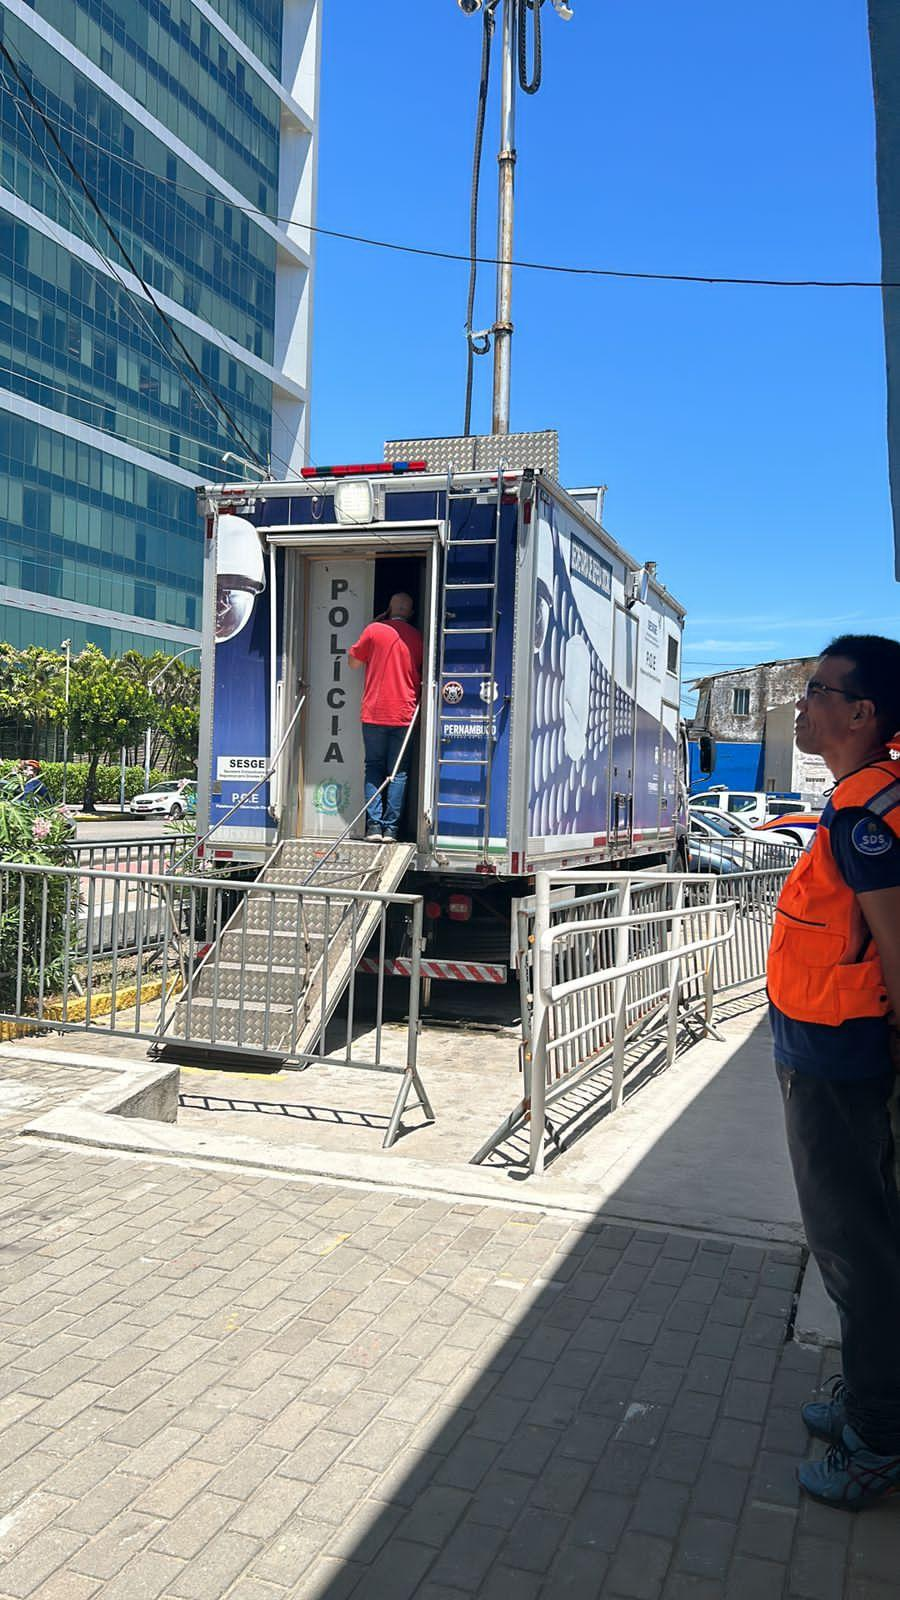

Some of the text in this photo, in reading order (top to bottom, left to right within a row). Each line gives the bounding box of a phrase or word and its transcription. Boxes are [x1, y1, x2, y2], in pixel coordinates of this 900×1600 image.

[323, 579, 349, 763] POLÍCIA
[230, 759, 265, 768] SESGE
[862, 835, 885, 845] SDS
